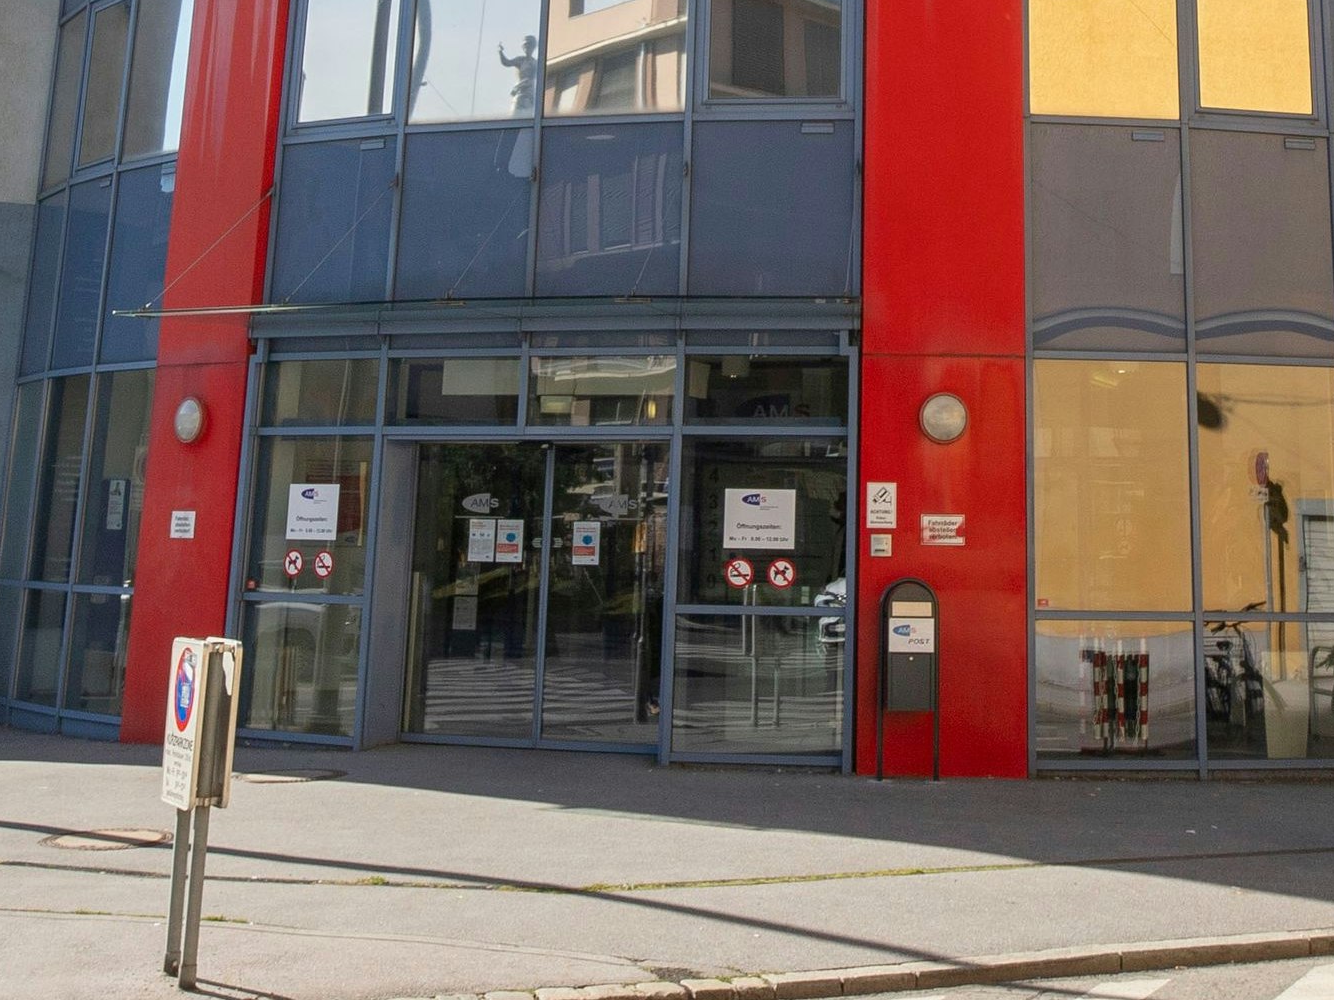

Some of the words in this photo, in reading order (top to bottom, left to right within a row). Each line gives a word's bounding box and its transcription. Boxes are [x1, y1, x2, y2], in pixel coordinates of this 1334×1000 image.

[470, 497, 500, 508] AMS
[746, 495, 767, 503] AMS
[736, 523, 782, 531] Öffnungszeiten:
[928, 519, 959, 527] Fahrräder
[898, 625, 917, 634] AMS
